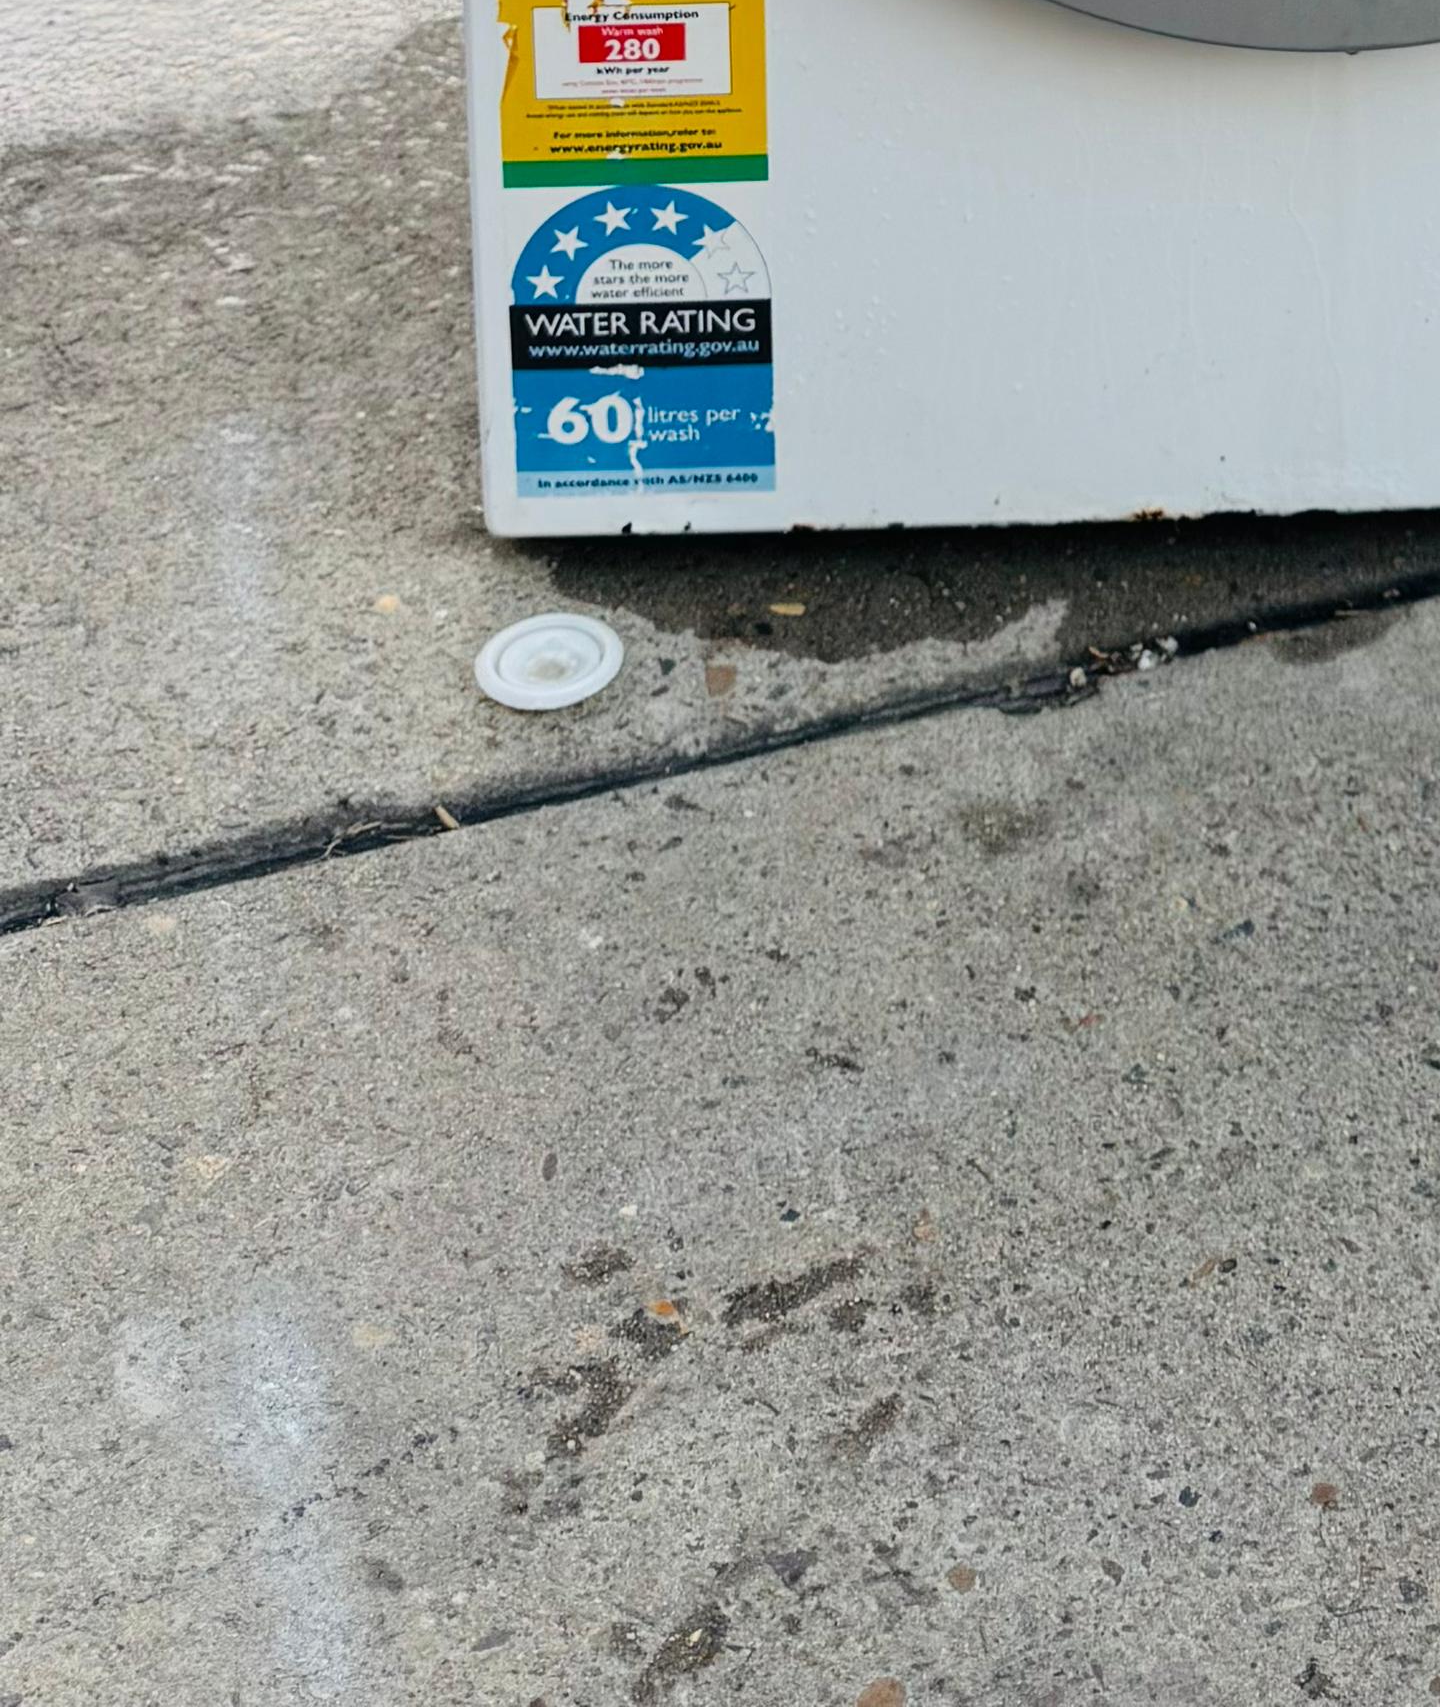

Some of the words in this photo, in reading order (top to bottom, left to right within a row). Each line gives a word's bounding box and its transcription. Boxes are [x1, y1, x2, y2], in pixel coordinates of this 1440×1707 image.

[565, 11, 609, 24] Energy
[613, 9, 699, 22] Consumption
[602, 26, 634, 36] Warm
[637, 25, 664, 35] wash
[604, 38, 660, 60] 280
[597, 66, 622, 74] kWh
[626, 68, 643, 76] per
[647, 66, 670, 74] year
[553, 131, 571, 139] For
[574, 131, 602, 139] more
[550, 140, 723, 154] www.energyrating.gov.au
[609, 259, 634, 270] The
[638, 261, 673, 270] more
[593, 276, 624, 285] stars
[630, 274, 650, 284] the
[655, 274, 689, 283] more
[591, 289, 629, 298] water
[633, 287, 684, 297] efficient
[525, 312, 630, 336] WATER
[640, 308, 756, 335] RATING
[528, 339, 760, 357] www.waterrating.gov.au
[547, 392, 633, 445] 60
[648, 406, 699, 423] litres
[705, 408, 741, 426] per
[648, 424, 700, 441] wash
[555, 477, 629, 488] accordance
[726, 473, 758, 484] 6400
